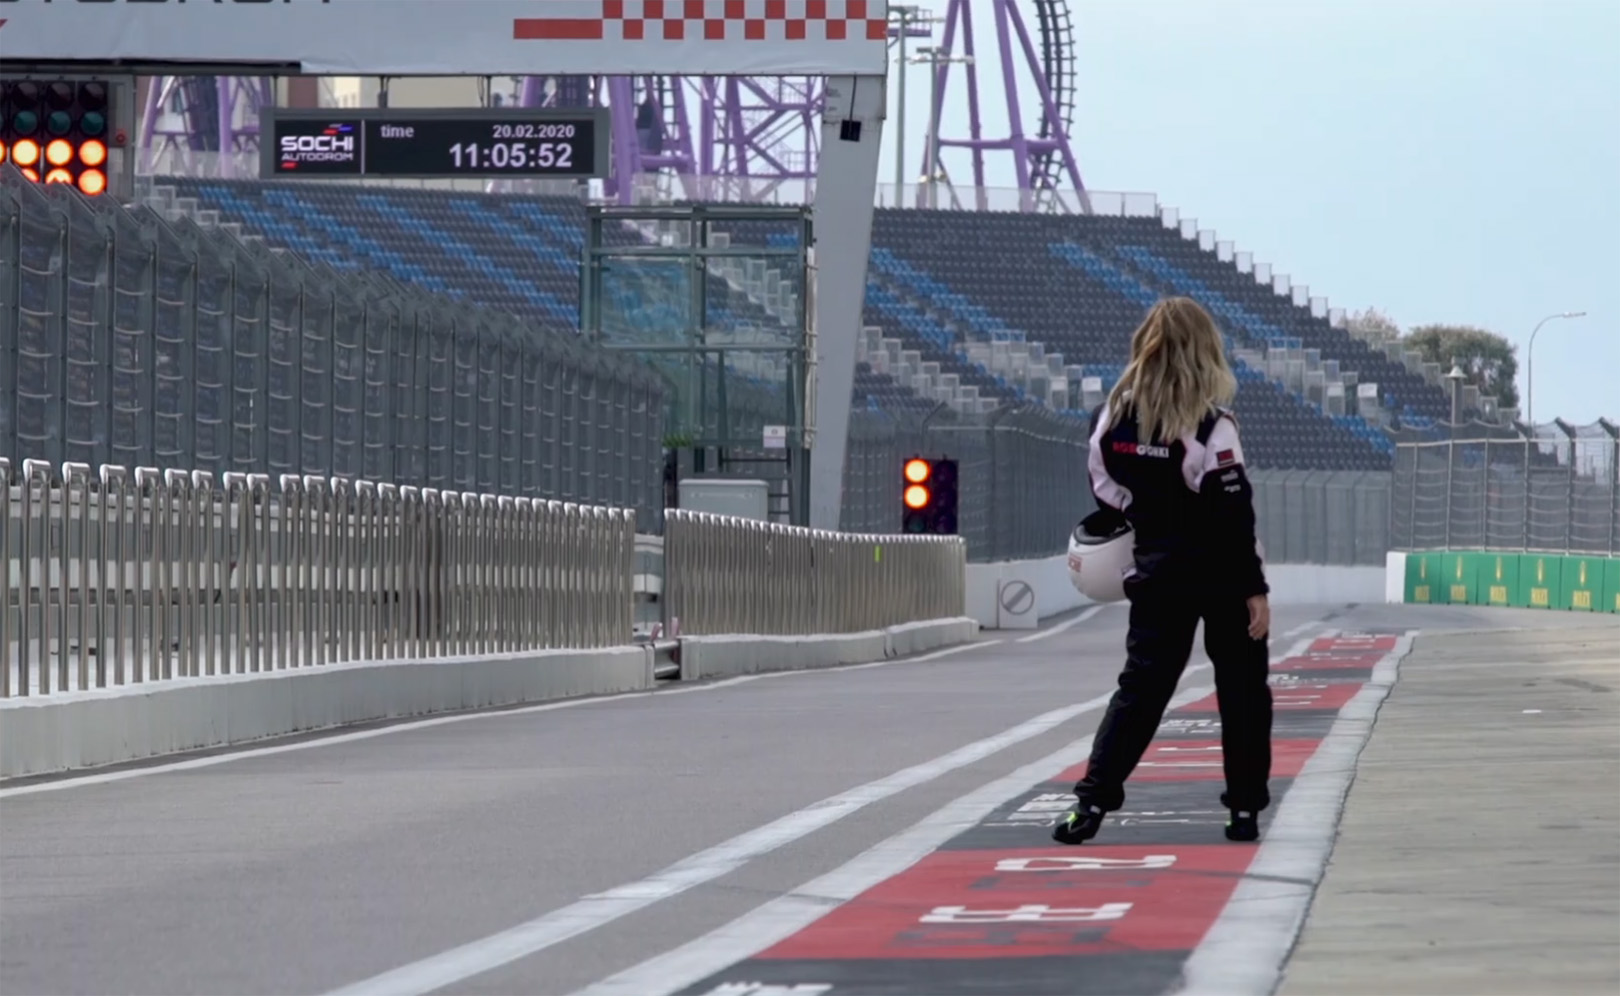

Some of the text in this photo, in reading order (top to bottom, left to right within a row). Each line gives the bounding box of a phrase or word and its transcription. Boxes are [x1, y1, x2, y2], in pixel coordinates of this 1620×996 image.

[380, 124, 415, 138] time
[492, 124, 575, 138] 20.02.2020
[280, 135, 354, 151] SOCHI
[280, 152, 354, 161] AUTODROM
[449, 142, 572, 168] 11:05:52
